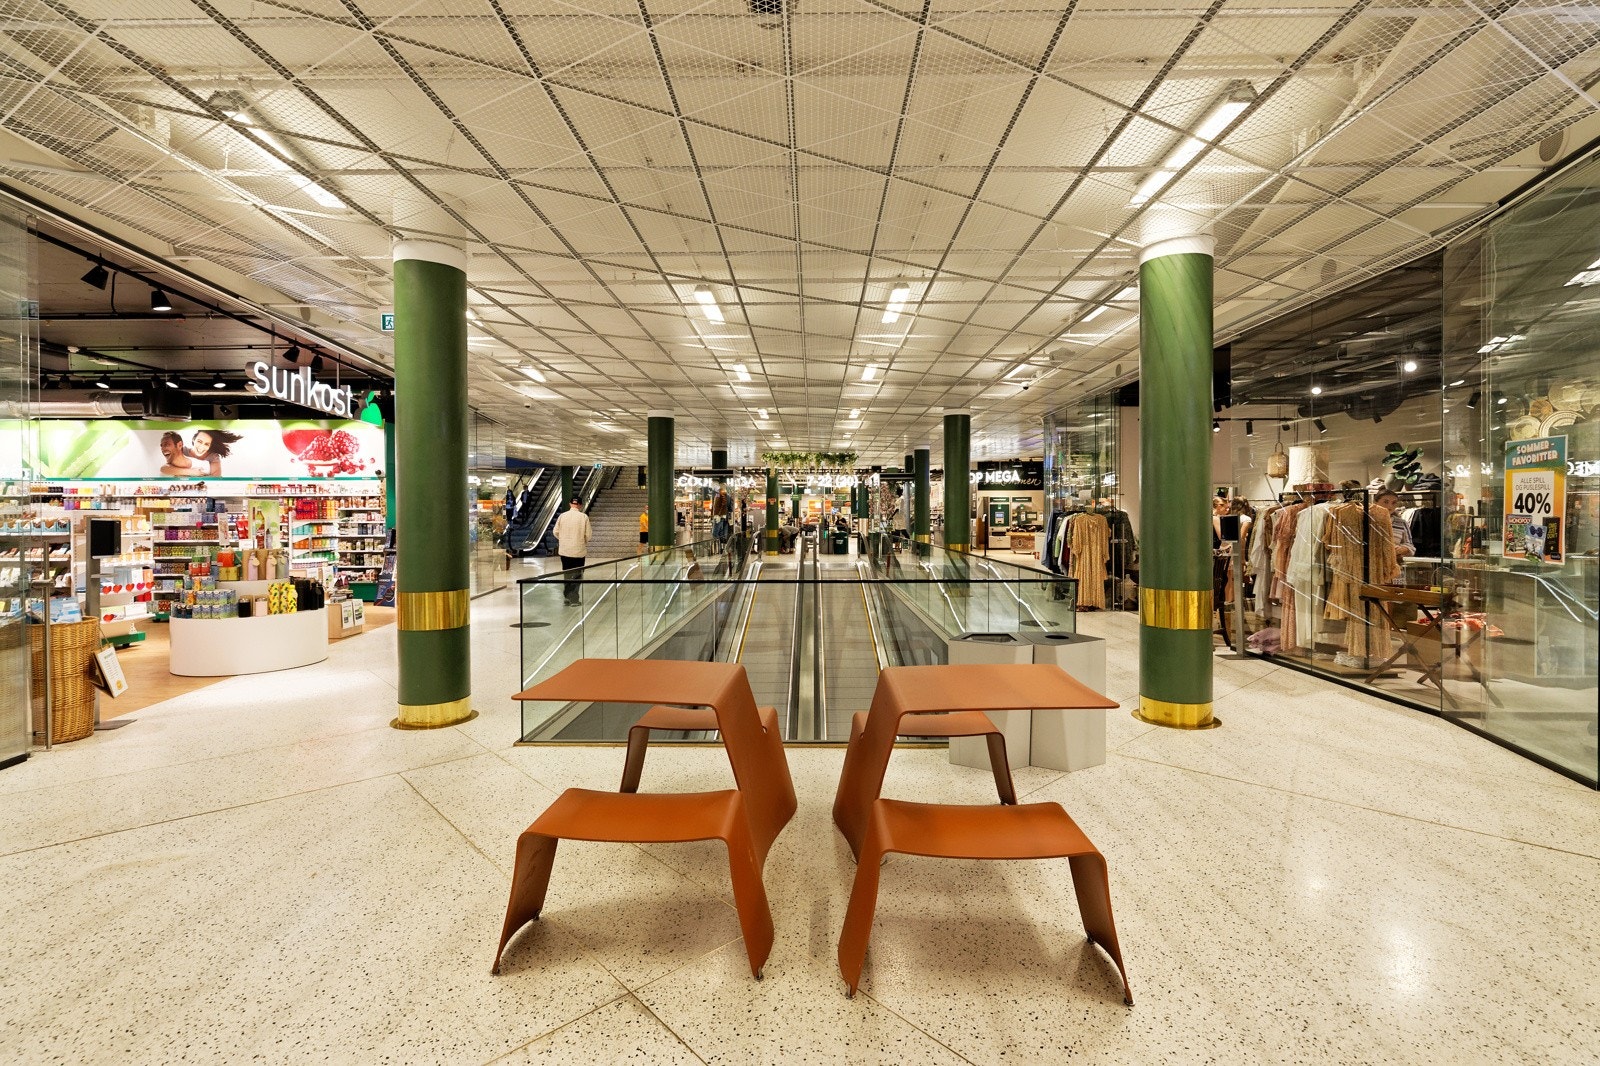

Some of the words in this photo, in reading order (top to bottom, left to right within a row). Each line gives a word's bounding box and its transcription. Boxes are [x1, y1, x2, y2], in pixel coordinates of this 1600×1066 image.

[248, 361, 353, 419] sunkost
[1512, 450, 1558, 465] FAVORITTER
[985, 469, 1021, 483] MEGA
[1514, 492, 1552, 514] 40%
